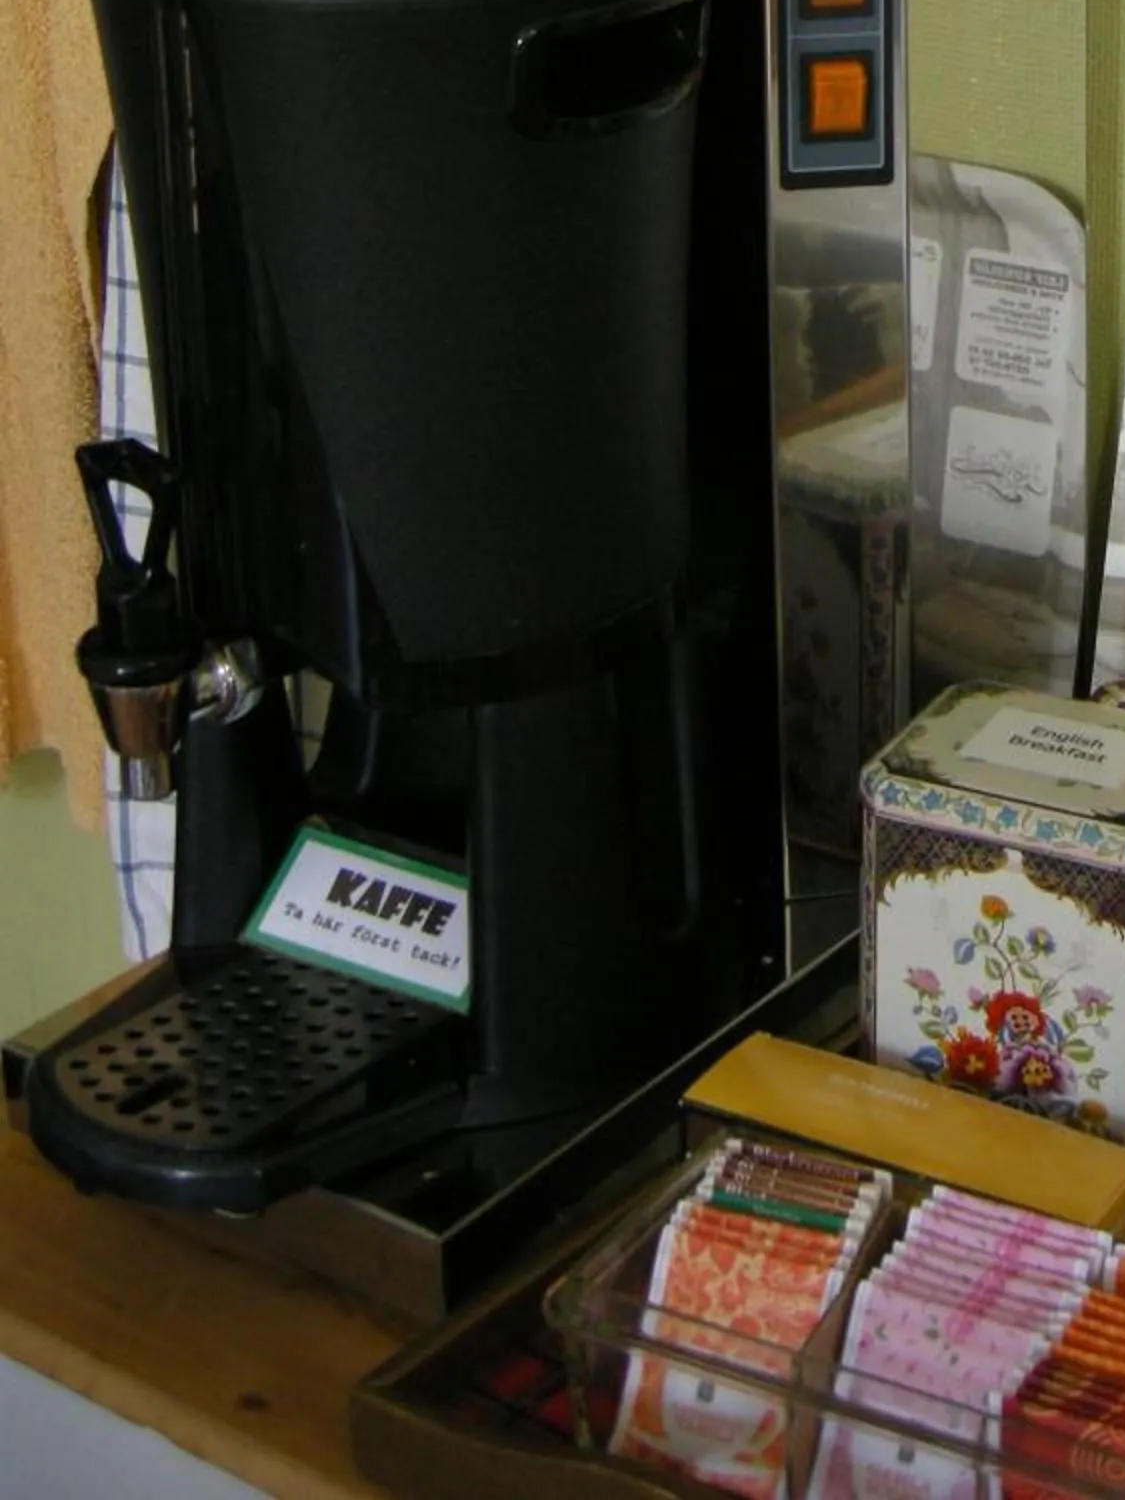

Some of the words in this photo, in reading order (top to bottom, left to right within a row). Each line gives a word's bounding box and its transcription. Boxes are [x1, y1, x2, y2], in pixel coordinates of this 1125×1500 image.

[1007, 733, 1107, 764] Breakfast
[1029, 725, 1105, 749] English
[283, 901, 304, 920] Ta
[326, 867, 458, 937] KAFFE
